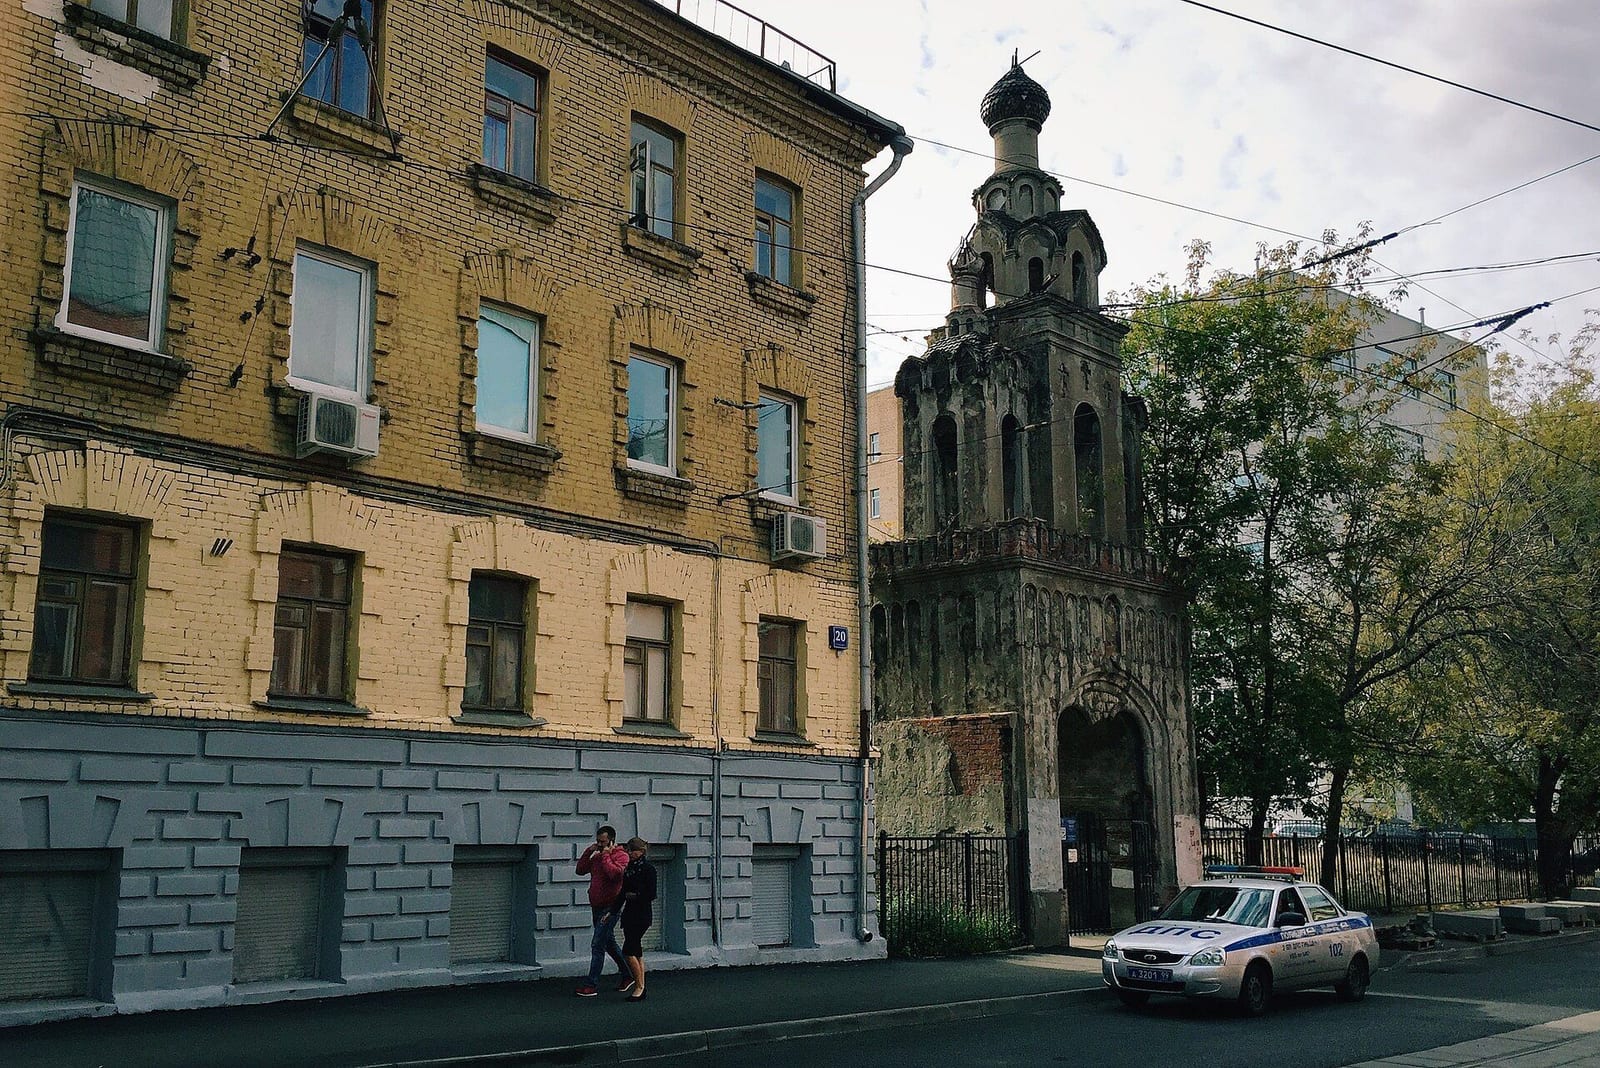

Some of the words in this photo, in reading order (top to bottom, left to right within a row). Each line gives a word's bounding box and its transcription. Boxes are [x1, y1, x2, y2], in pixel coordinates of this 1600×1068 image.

[835, 630, 846, 642] 20
[1127, 926, 1222, 939] ДПС
[1329, 942, 1344, 957] 102
[1138, 969, 1157, 980] 3201
